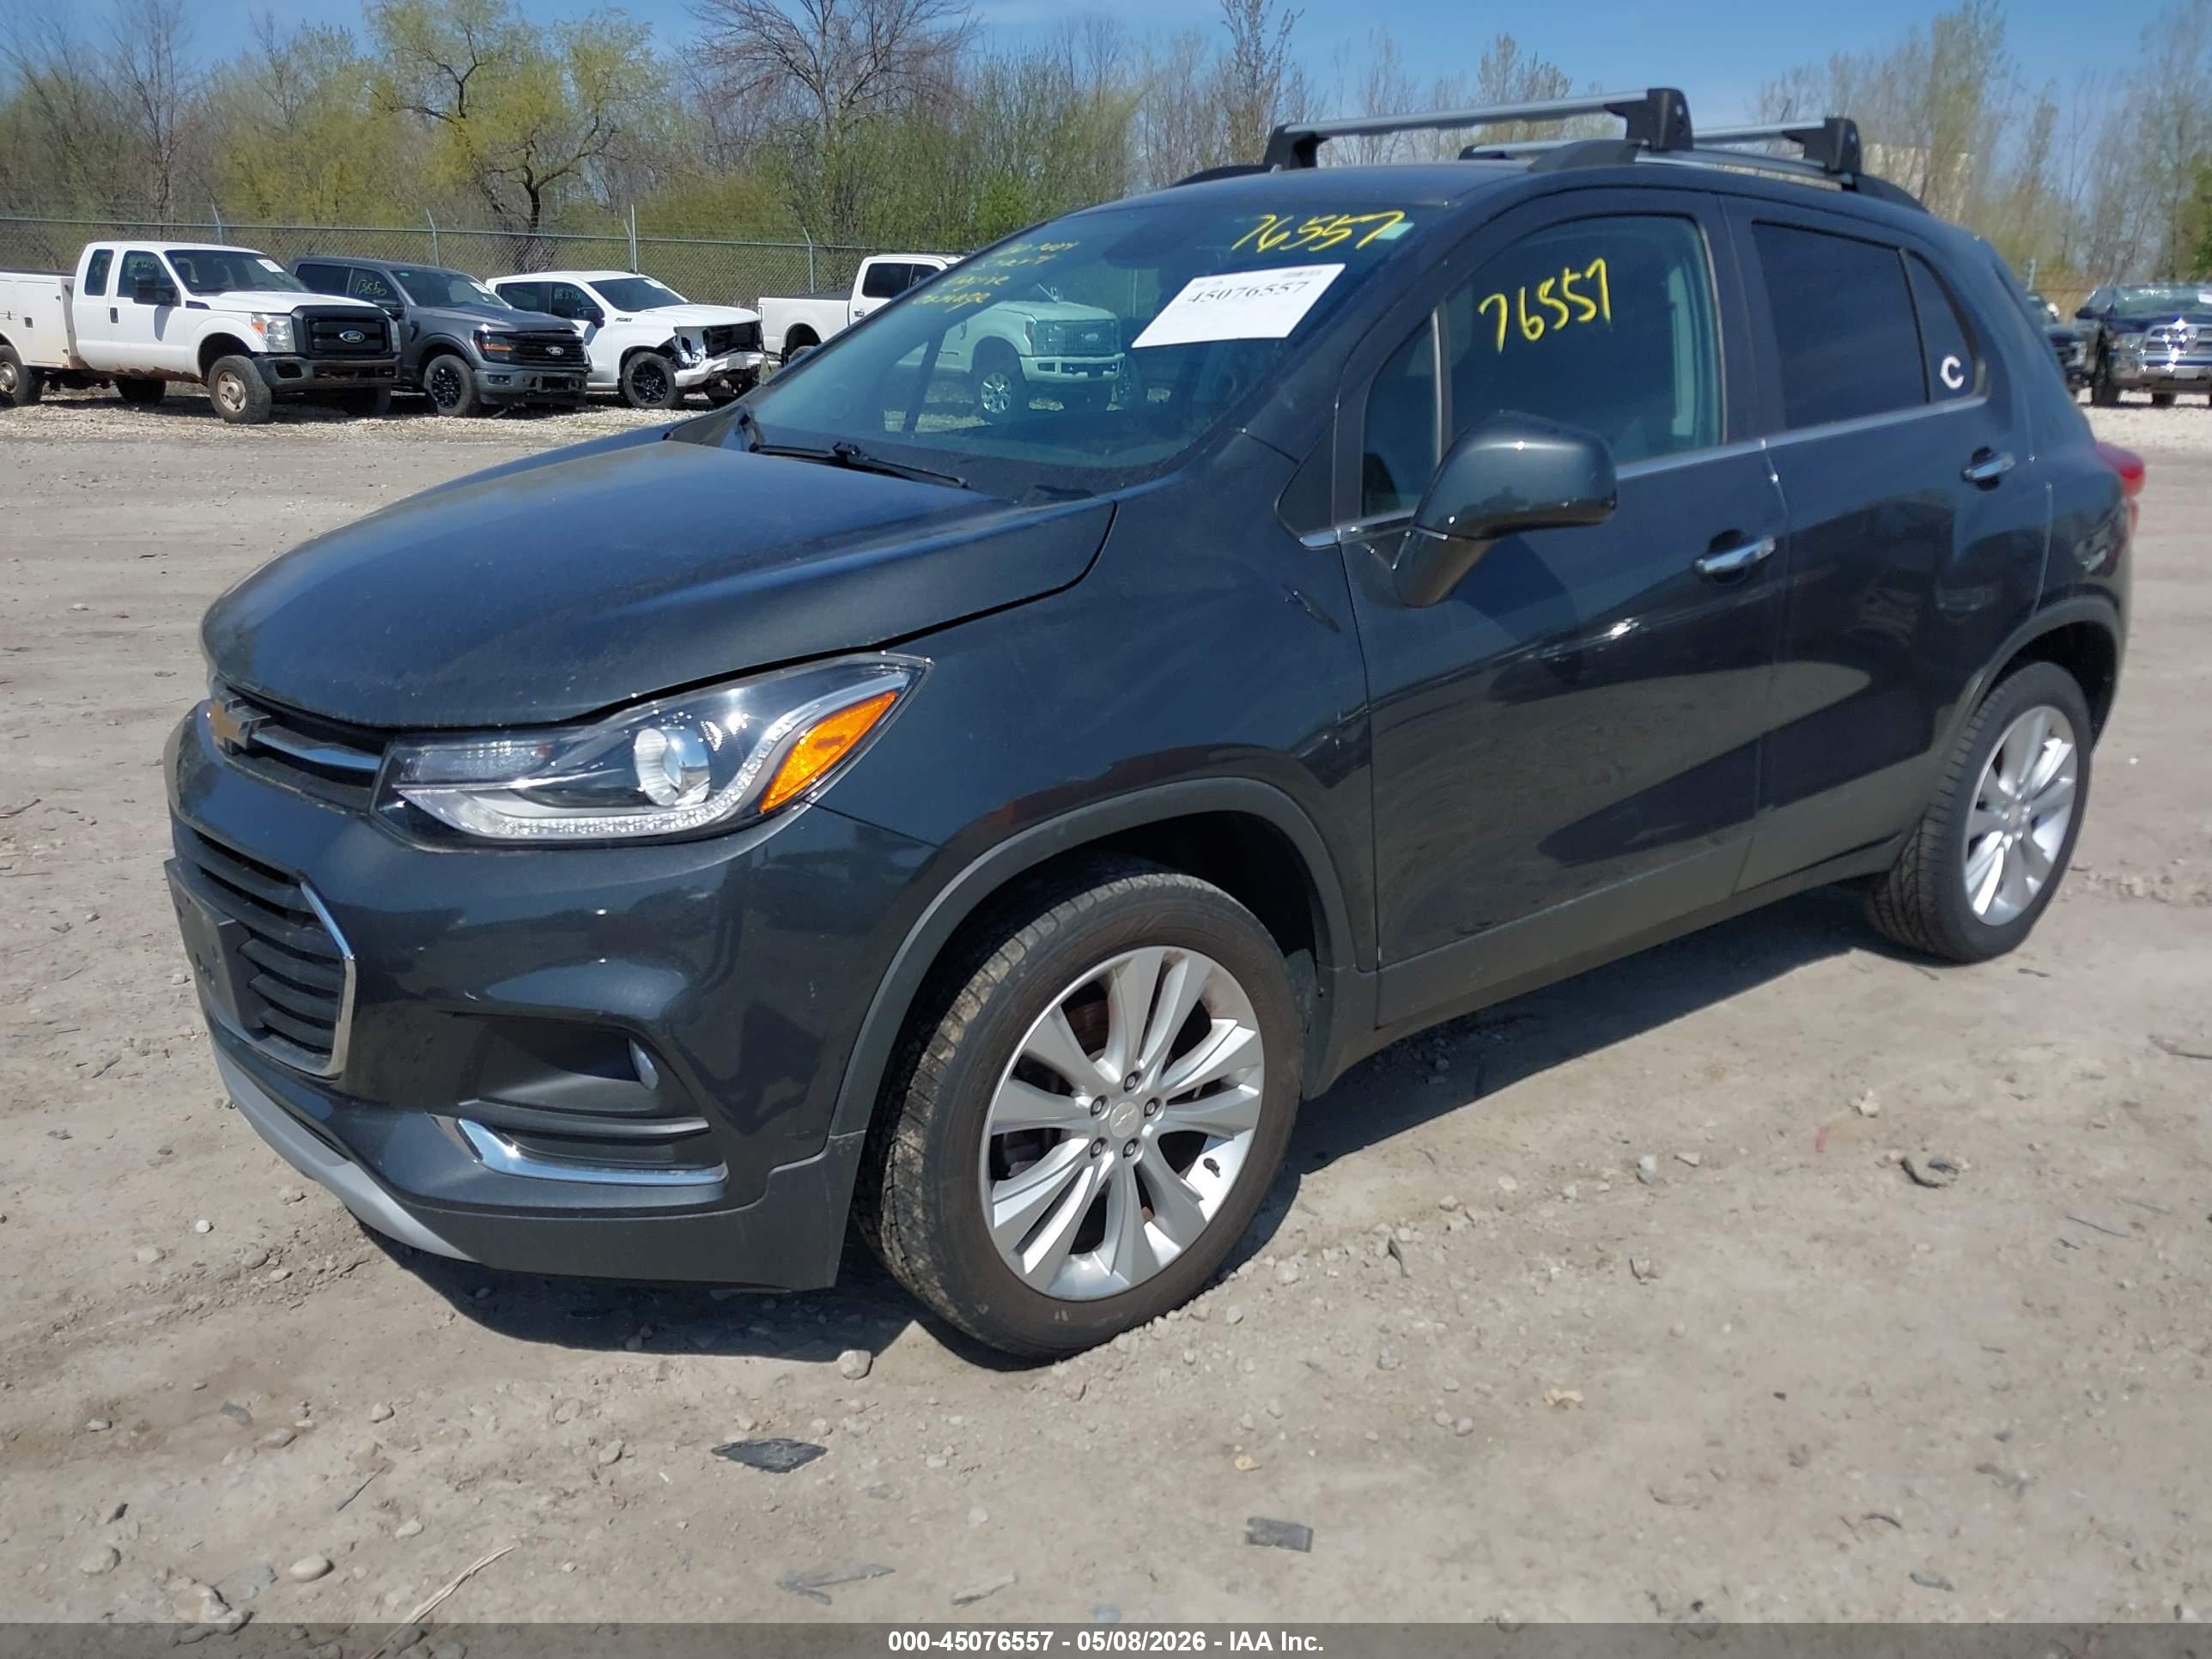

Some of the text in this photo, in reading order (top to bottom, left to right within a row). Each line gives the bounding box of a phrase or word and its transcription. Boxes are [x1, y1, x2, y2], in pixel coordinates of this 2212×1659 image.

[1231, 210, 1406, 252] 76557
[1188, 281, 1310, 302] 45076557
[1479, 257, 1612, 353] 76557
